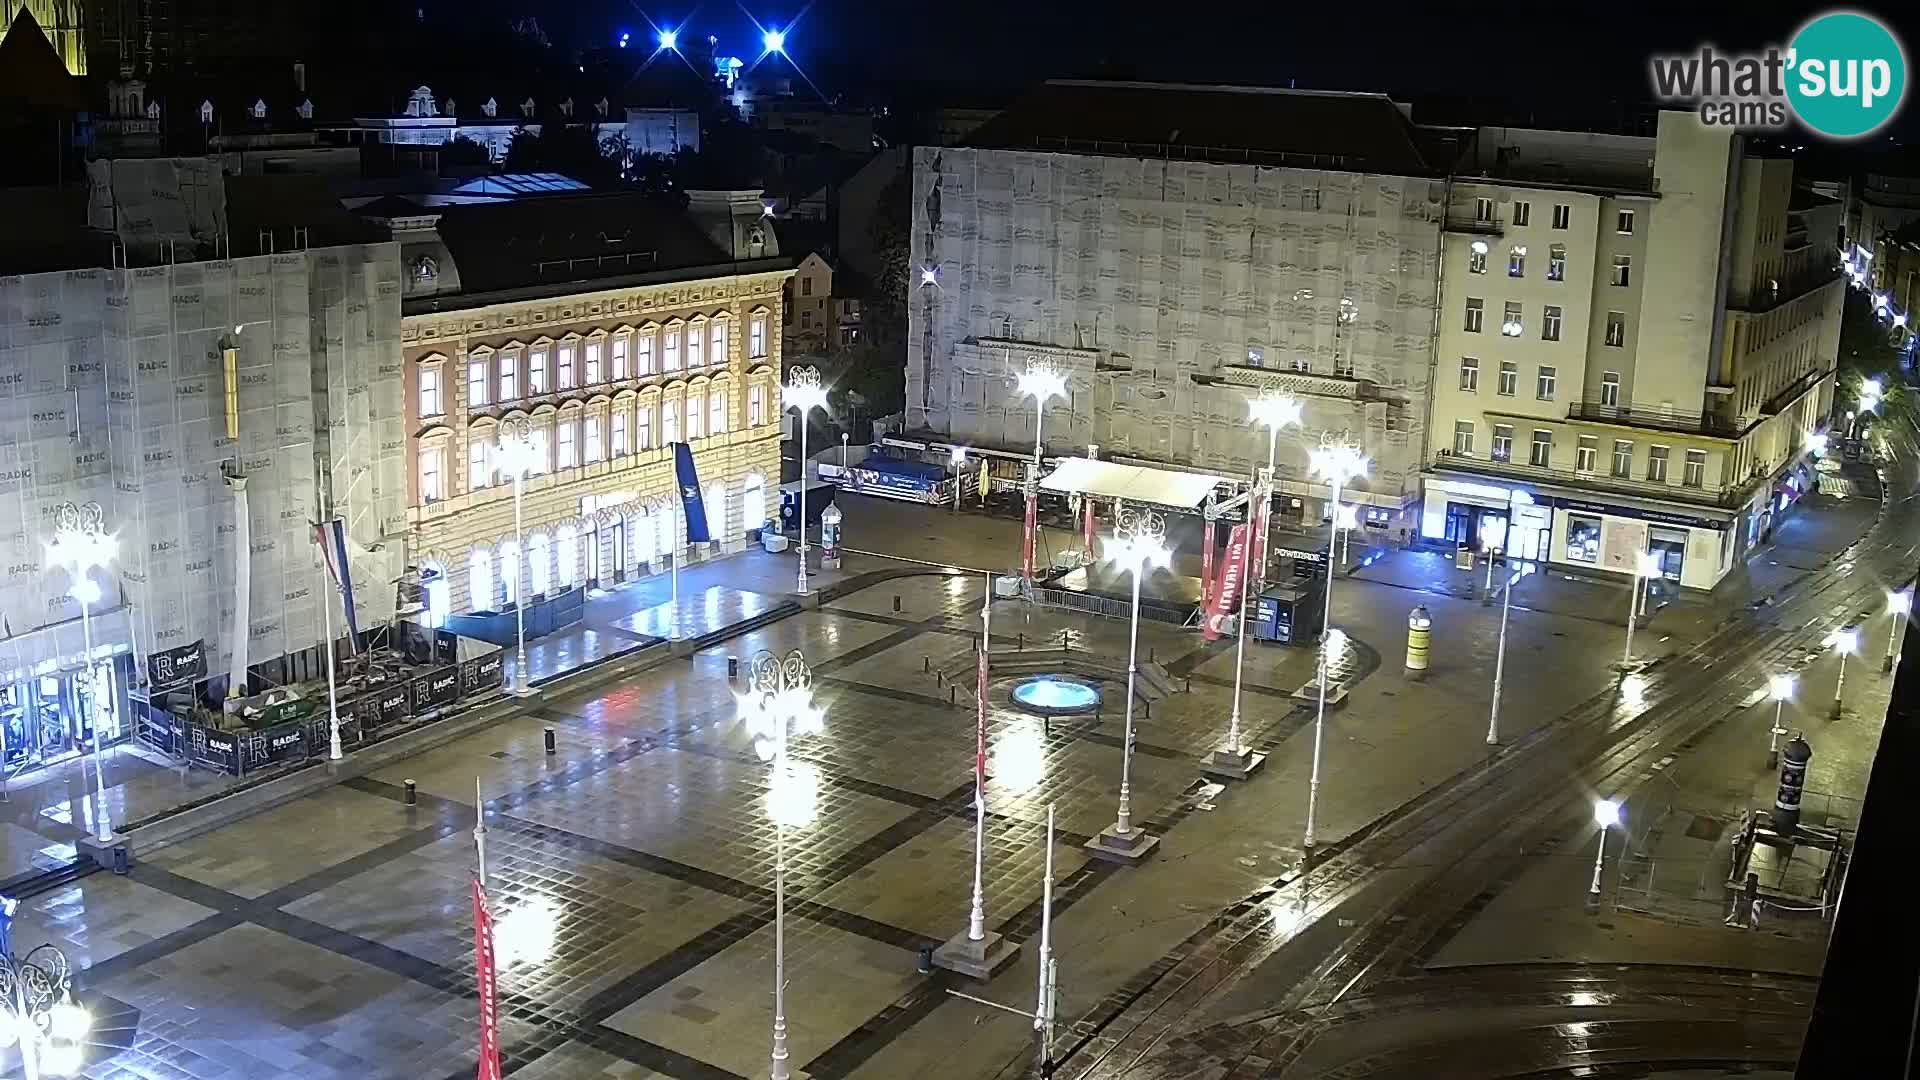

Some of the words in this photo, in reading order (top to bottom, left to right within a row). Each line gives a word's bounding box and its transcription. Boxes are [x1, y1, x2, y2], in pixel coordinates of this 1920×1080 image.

[70, 363, 101, 374] RADIC
[138, 361, 168, 371] RADIC
[33, 411, 65, 422] RADIC
[76, 452, 106, 465] RADIC
[0, 469, 32, 481] RADIC
[8, 563, 39, 576] RADIC
